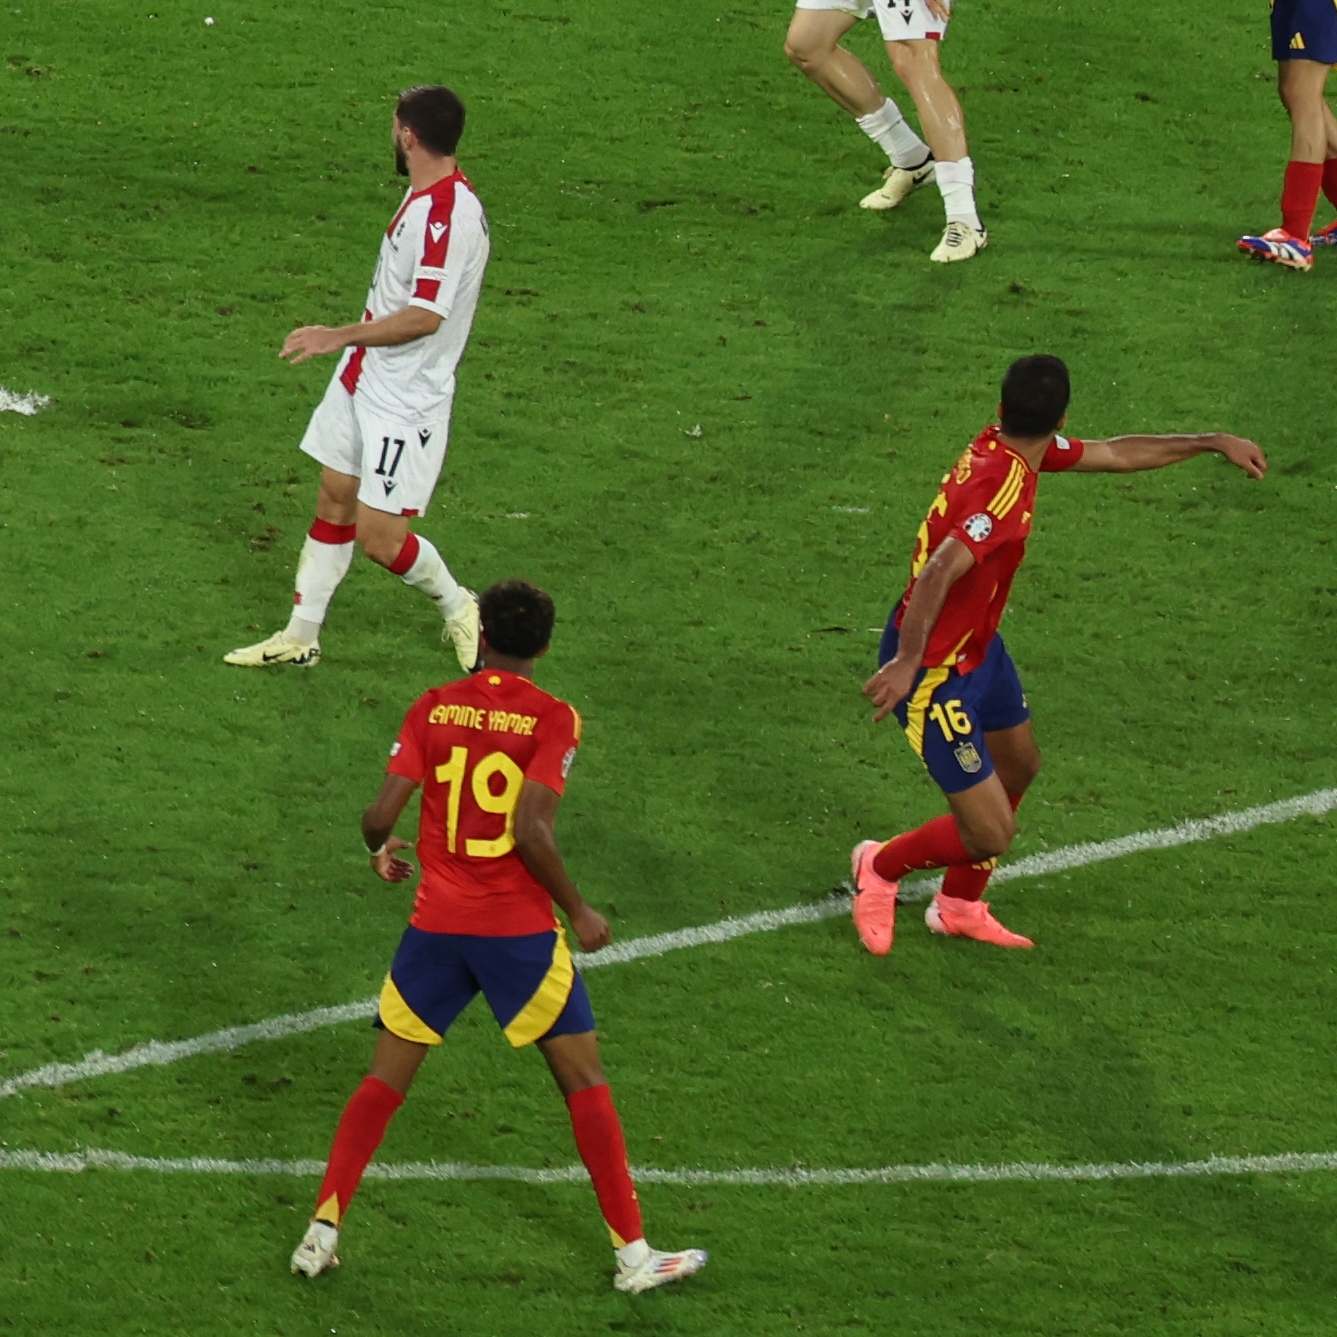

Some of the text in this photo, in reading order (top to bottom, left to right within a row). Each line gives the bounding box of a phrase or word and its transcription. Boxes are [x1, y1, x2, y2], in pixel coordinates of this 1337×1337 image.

[375, 436, 406, 478] 17
[428, 704, 539, 736] LAMINE YAMAL
[928, 699, 972, 742] 16
[435, 745, 525, 858] 19
